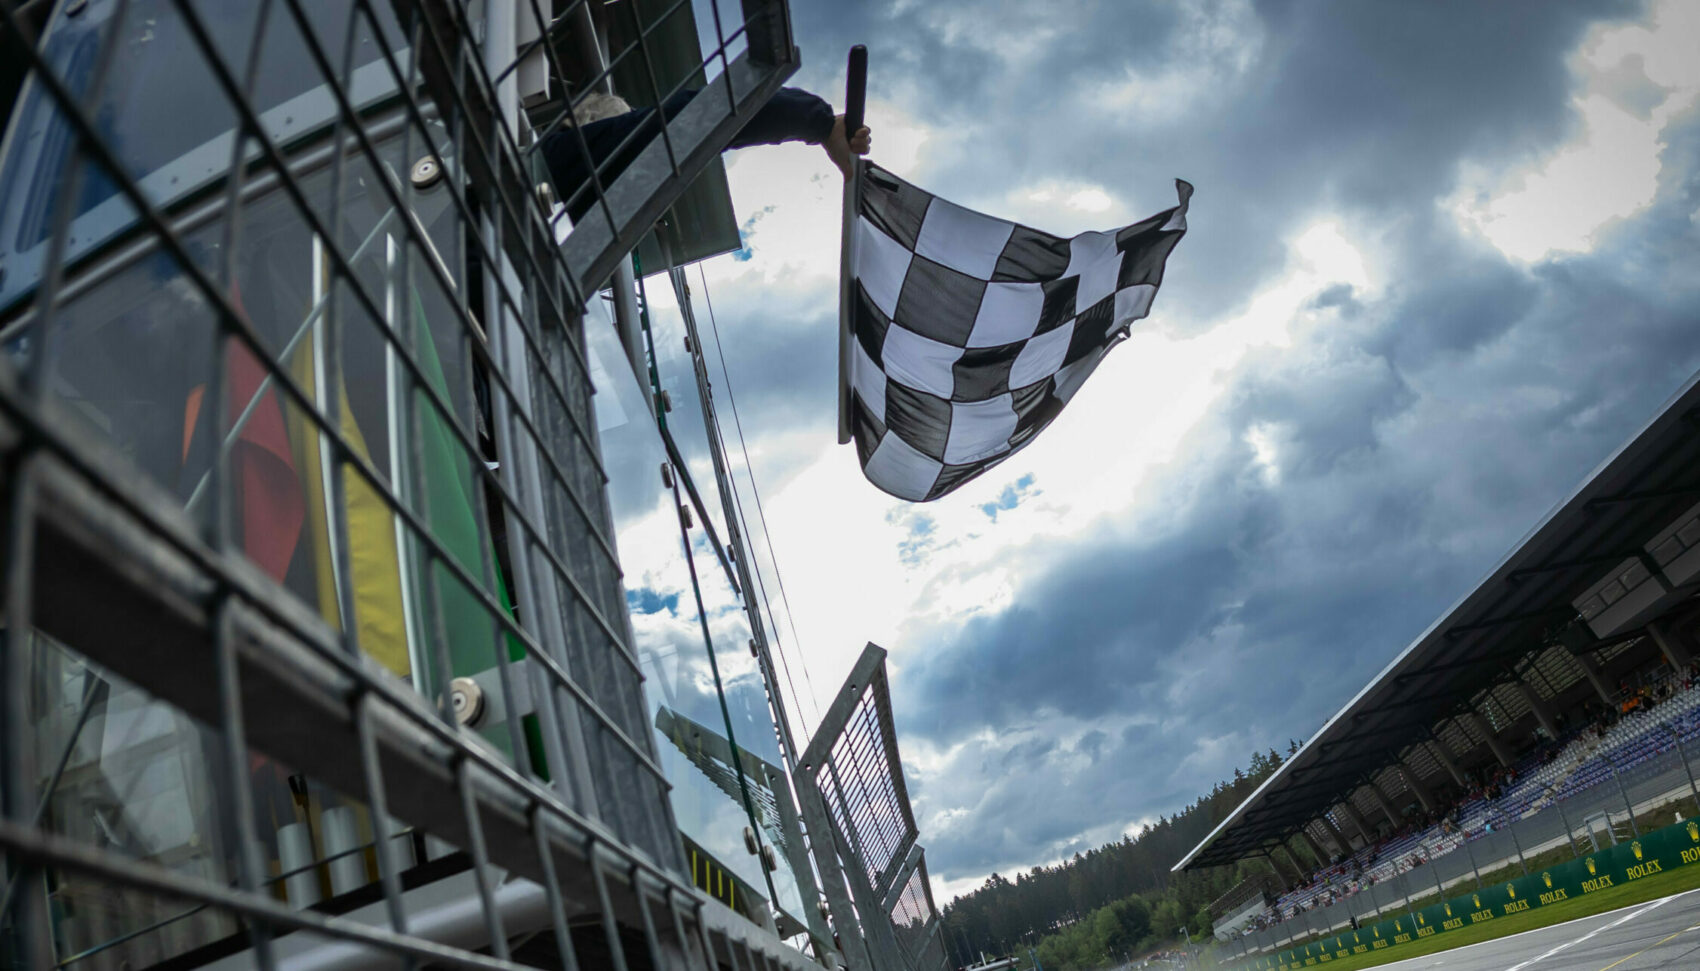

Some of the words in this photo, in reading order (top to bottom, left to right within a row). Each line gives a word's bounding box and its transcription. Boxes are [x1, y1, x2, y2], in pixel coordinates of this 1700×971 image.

[1626, 860, 1662, 880] ROLEX
[1582, 875, 1614, 893] ROLEX
[1539, 888, 1568, 905] ROLEX
[1504, 899, 1530, 914] ROLEX
[1442, 917, 1463, 930] ROLEX
[1471, 909, 1494, 922] ROLEX
